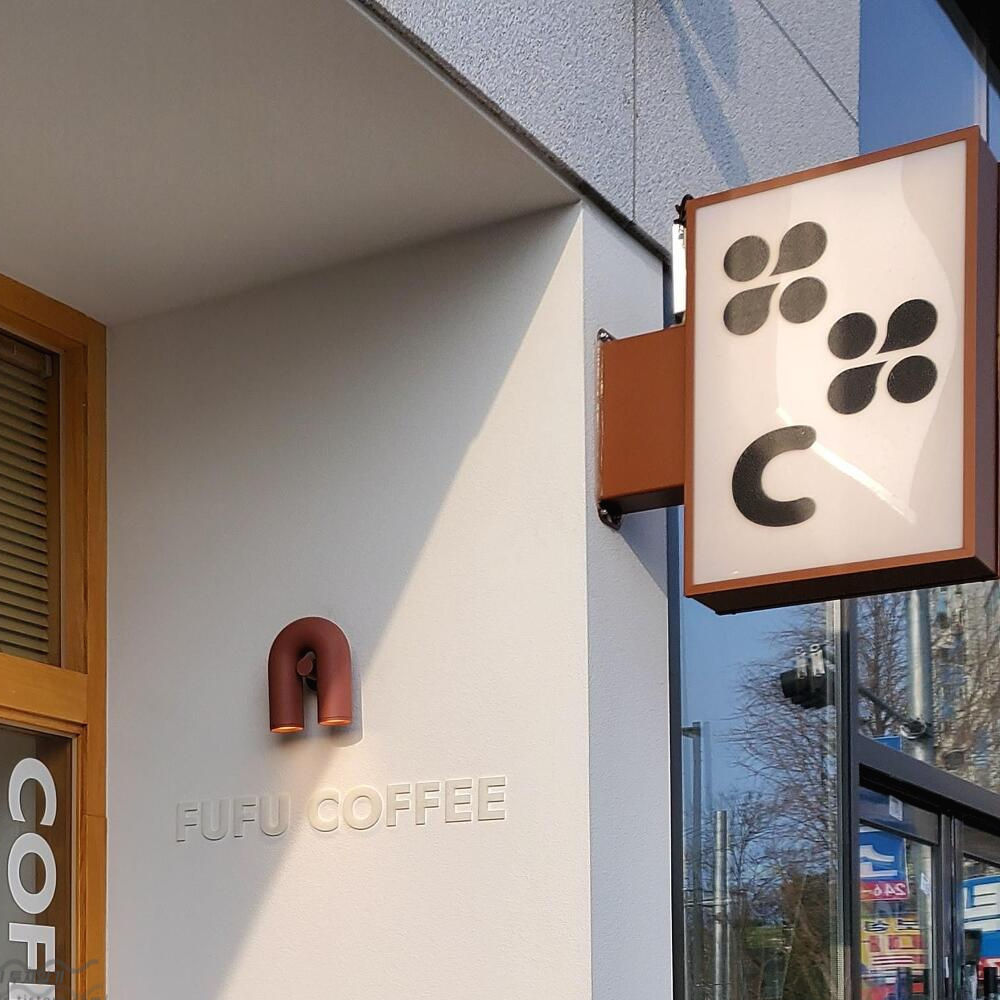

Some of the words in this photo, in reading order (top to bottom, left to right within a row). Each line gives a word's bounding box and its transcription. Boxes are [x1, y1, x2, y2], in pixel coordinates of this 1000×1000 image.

[732, 425, 817, 527] C
[176, 791, 291, 842] FUFU
[308, 776, 507, 832] COFFEE
